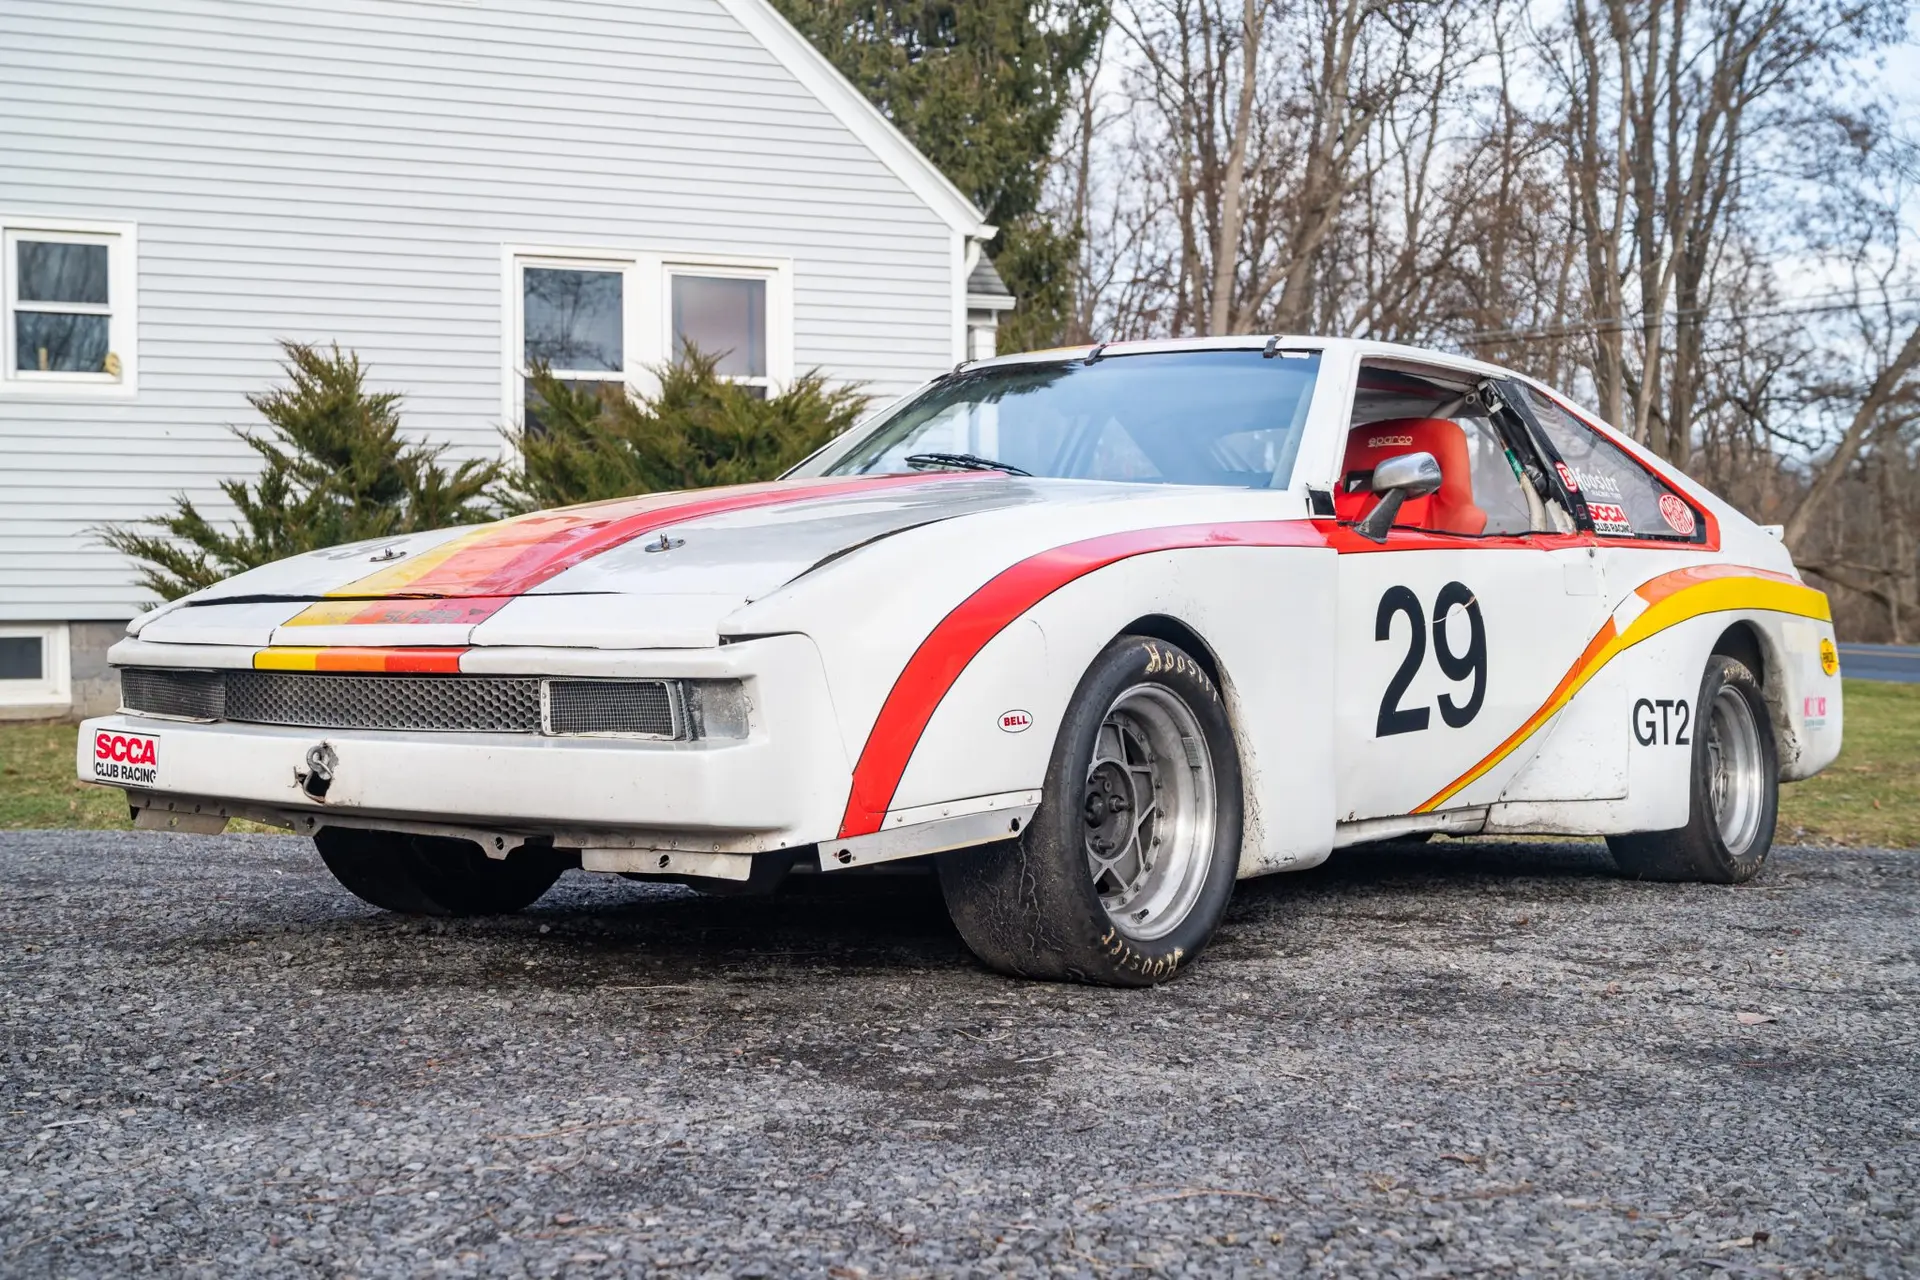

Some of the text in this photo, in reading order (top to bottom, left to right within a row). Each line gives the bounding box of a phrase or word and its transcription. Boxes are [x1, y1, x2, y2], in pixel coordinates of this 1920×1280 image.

[1588, 504, 1626, 521] SCCA
[1375, 581, 1487, 738] 29
[1003, 715, 1028, 727] BELL
[1632, 698, 1690, 746] GT2
[95, 733, 157, 766] SCCA
[95, 761, 157, 784] CLUB RACING
